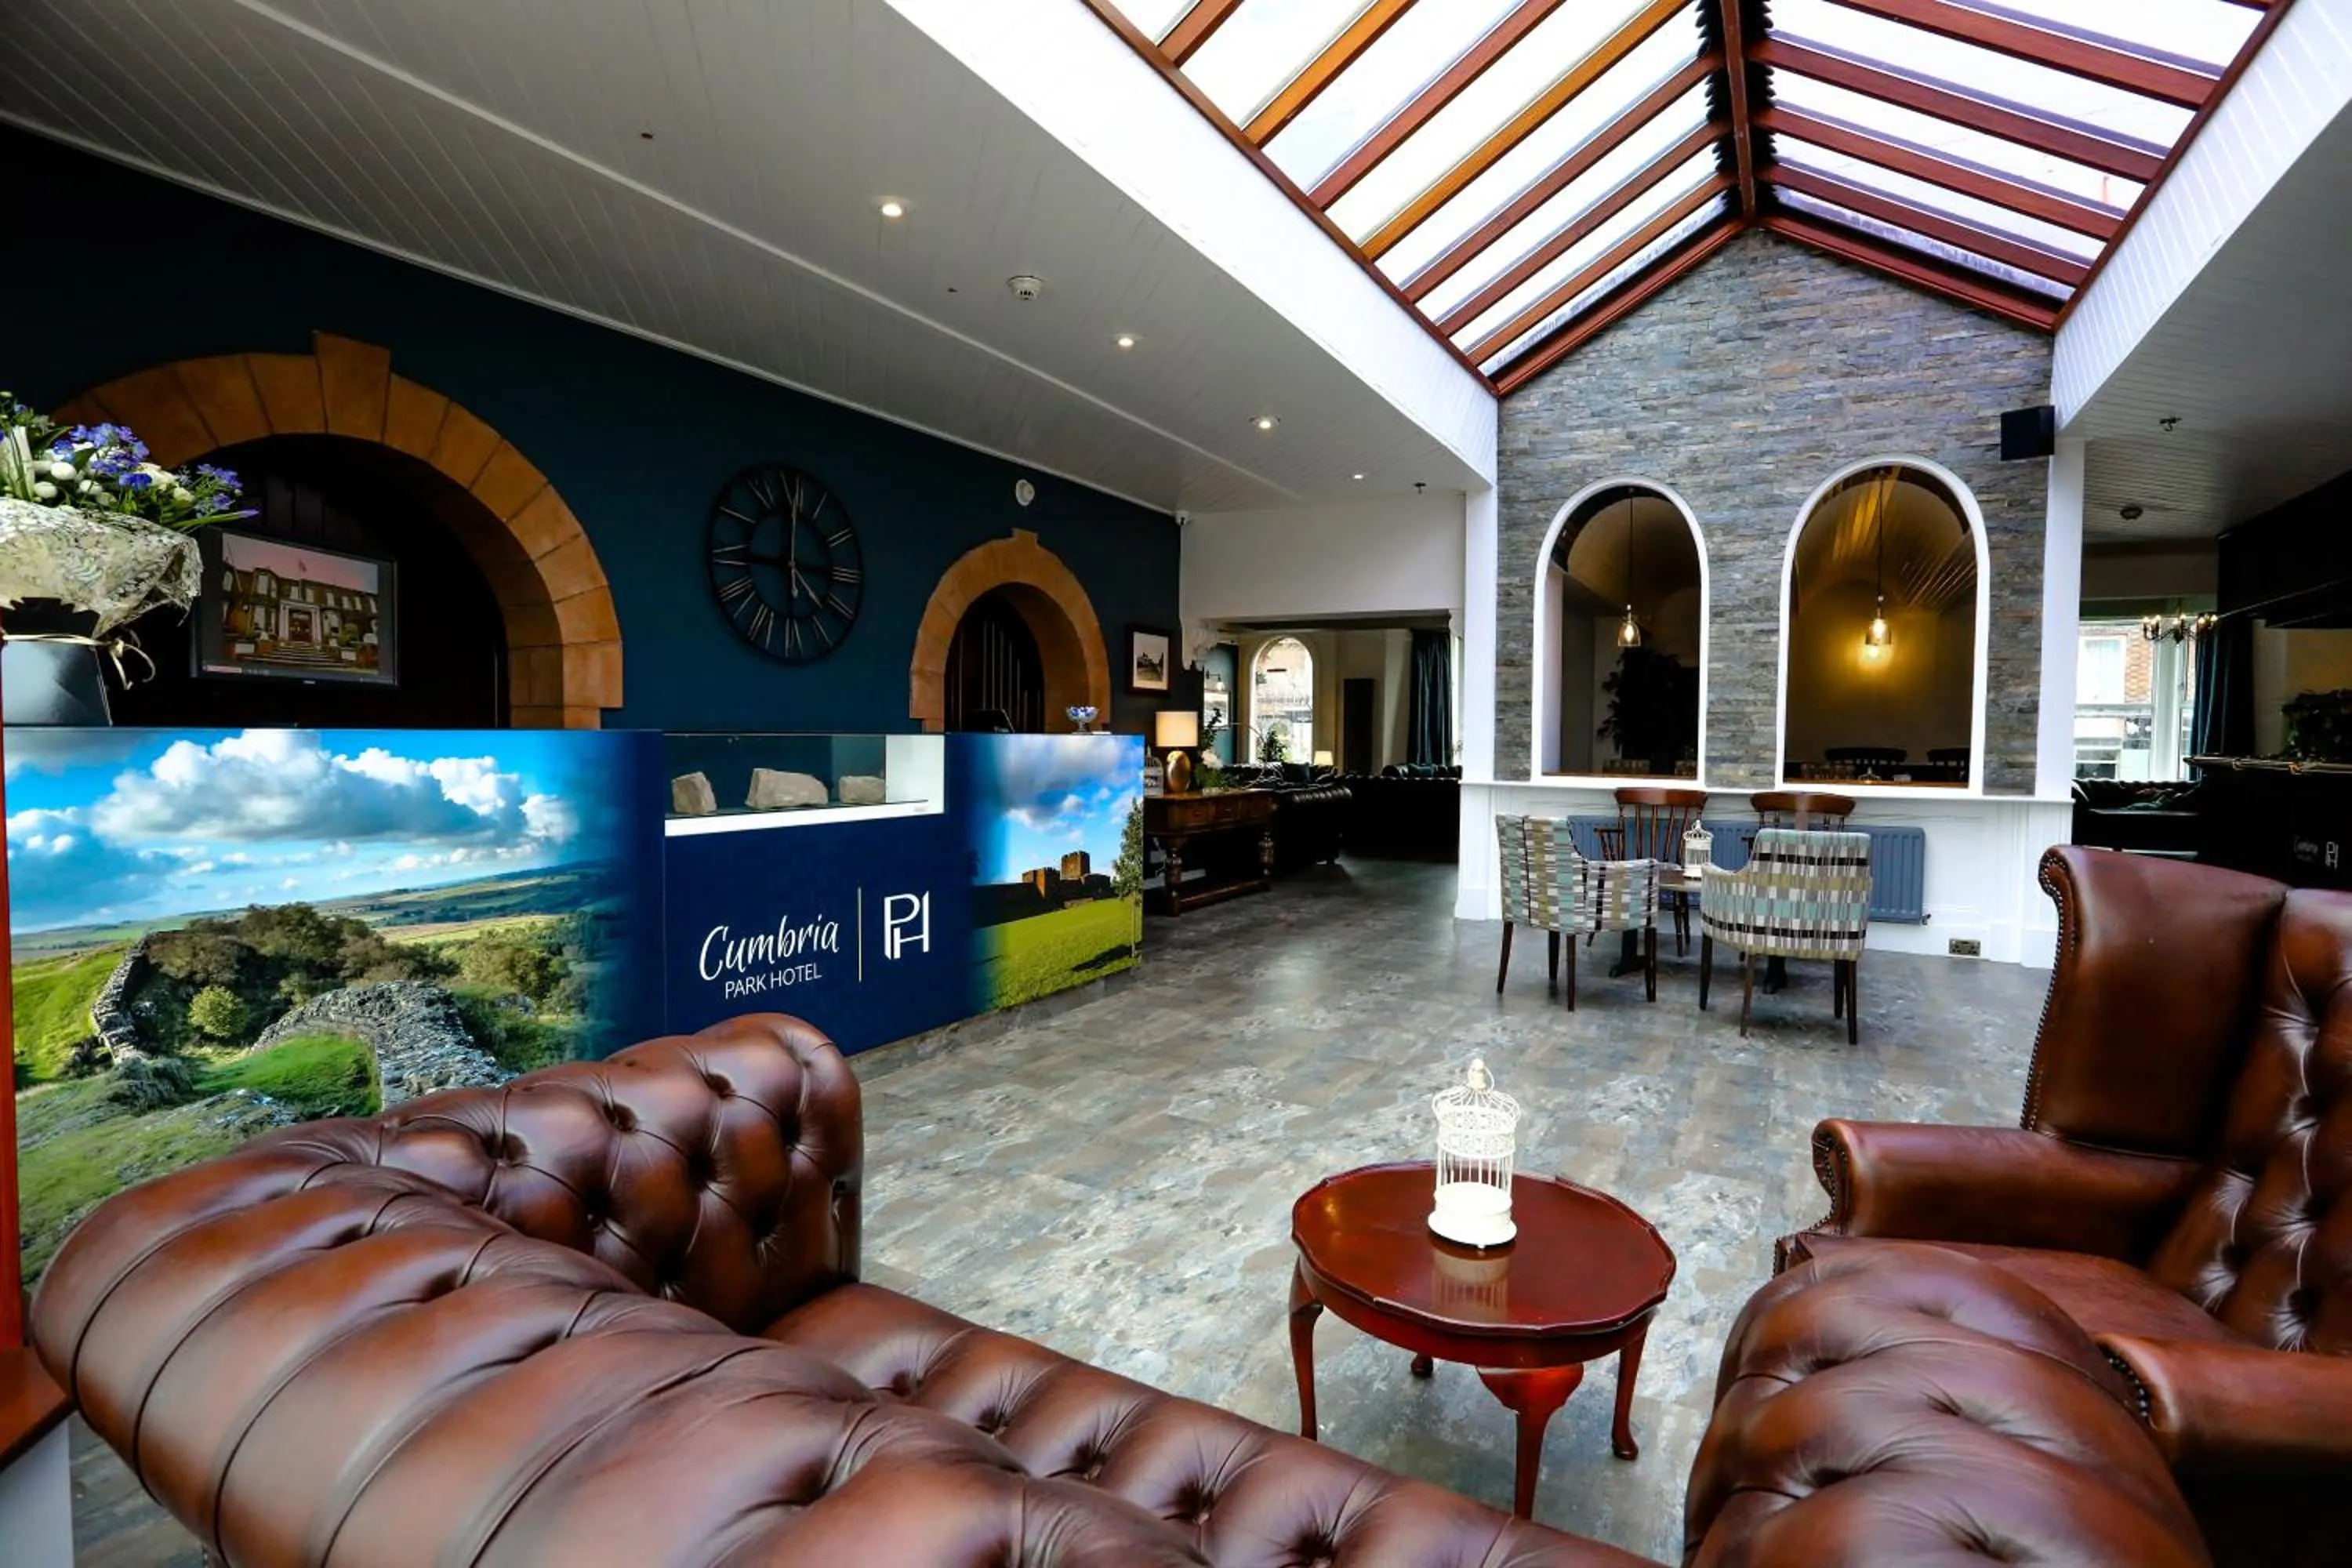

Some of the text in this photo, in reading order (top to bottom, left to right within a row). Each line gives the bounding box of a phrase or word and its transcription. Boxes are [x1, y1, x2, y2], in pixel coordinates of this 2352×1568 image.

[699, 913, 840, 981] Cumbria
[725, 962, 822, 1000] PARK HOTEL
